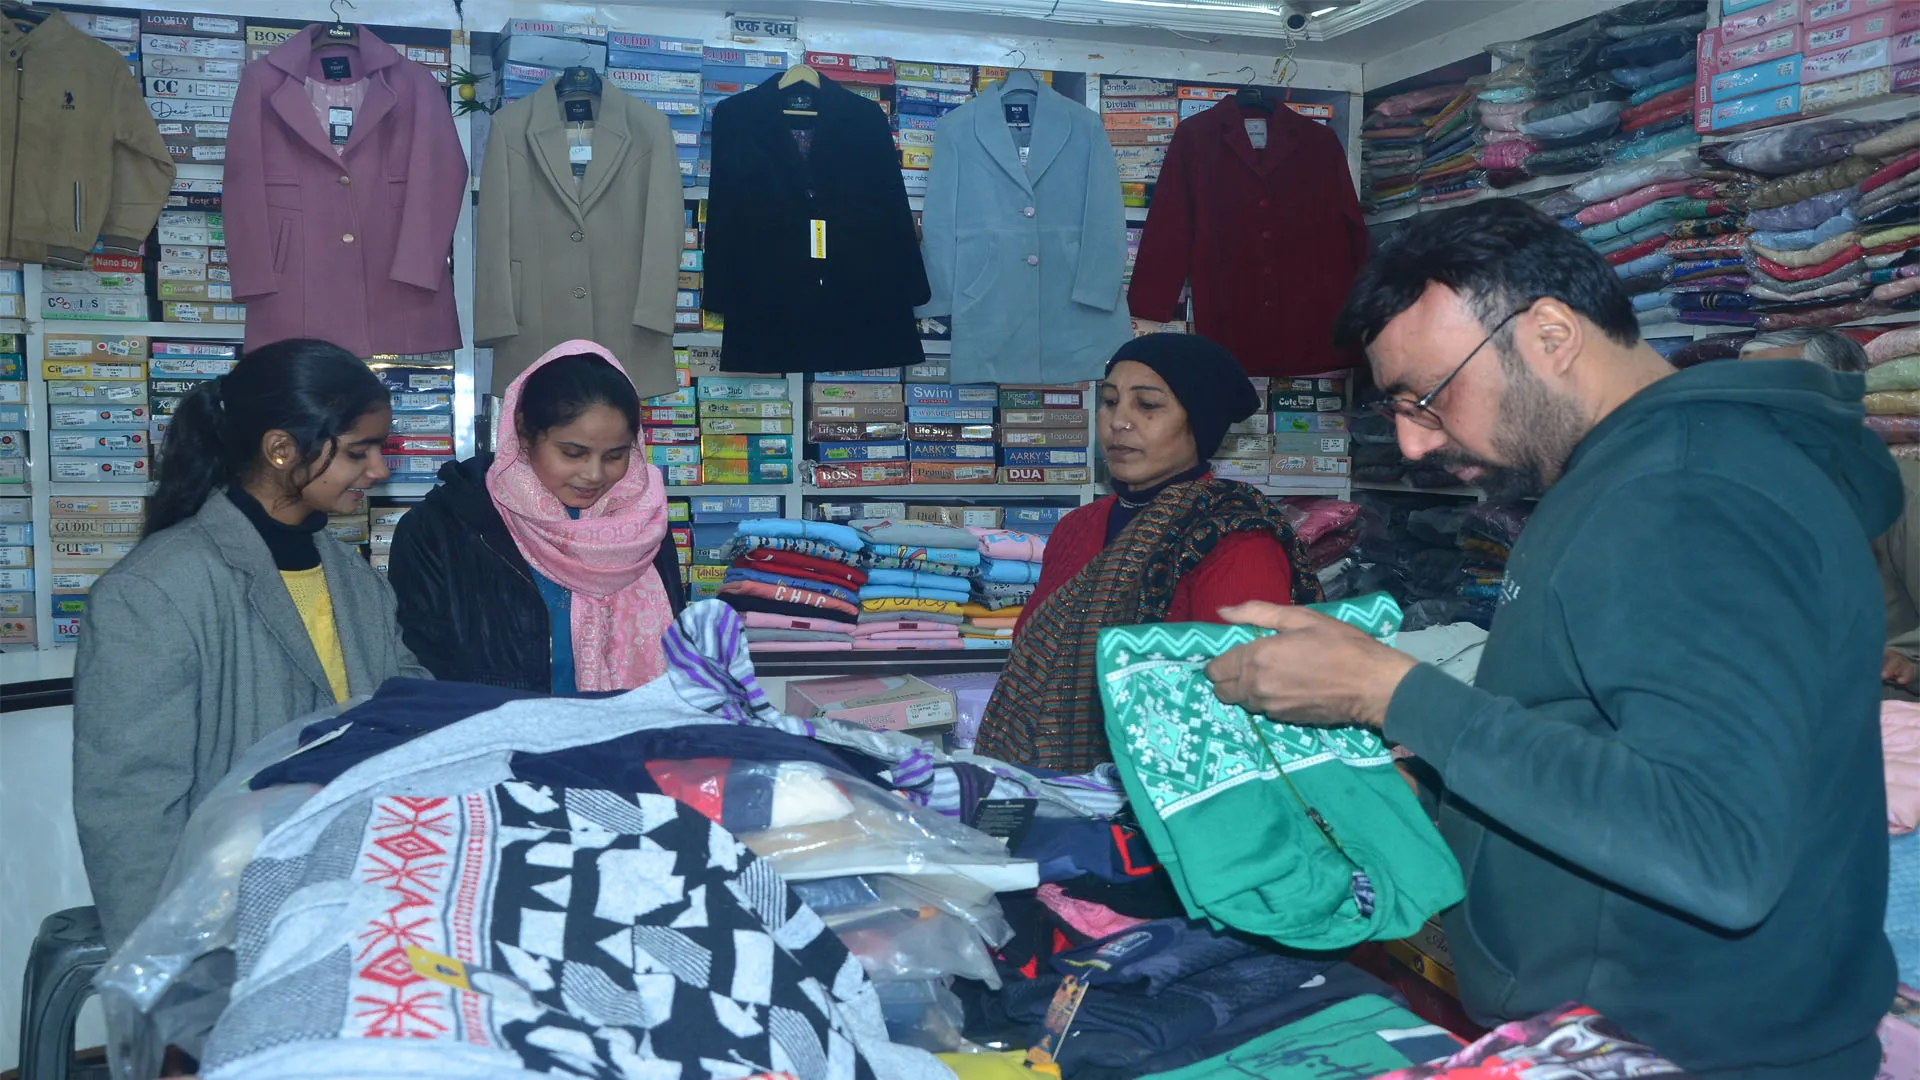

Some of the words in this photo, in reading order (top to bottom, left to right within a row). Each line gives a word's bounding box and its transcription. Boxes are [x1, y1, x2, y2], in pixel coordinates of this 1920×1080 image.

[735, 20, 760, 32] एक
[763, 21, 793, 36] दाम
[613, 71, 653, 82] GUDDU
[153, 79, 179, 94] CC
[121, 259, 139, 270] Boy
[818, 426, 834, 434] Life
[836, 425, 858, 436] Style
[915, 445, 956, 454] AARKY'S
[1010, 452, 1050, 460] AARKY'S
[822, 470, 857, 480] BOSS
[1009, 469, 1041, 479] DUA
[56, 522, 98, 532] GUDDU
[775, 586, 827, 608] CHIC
